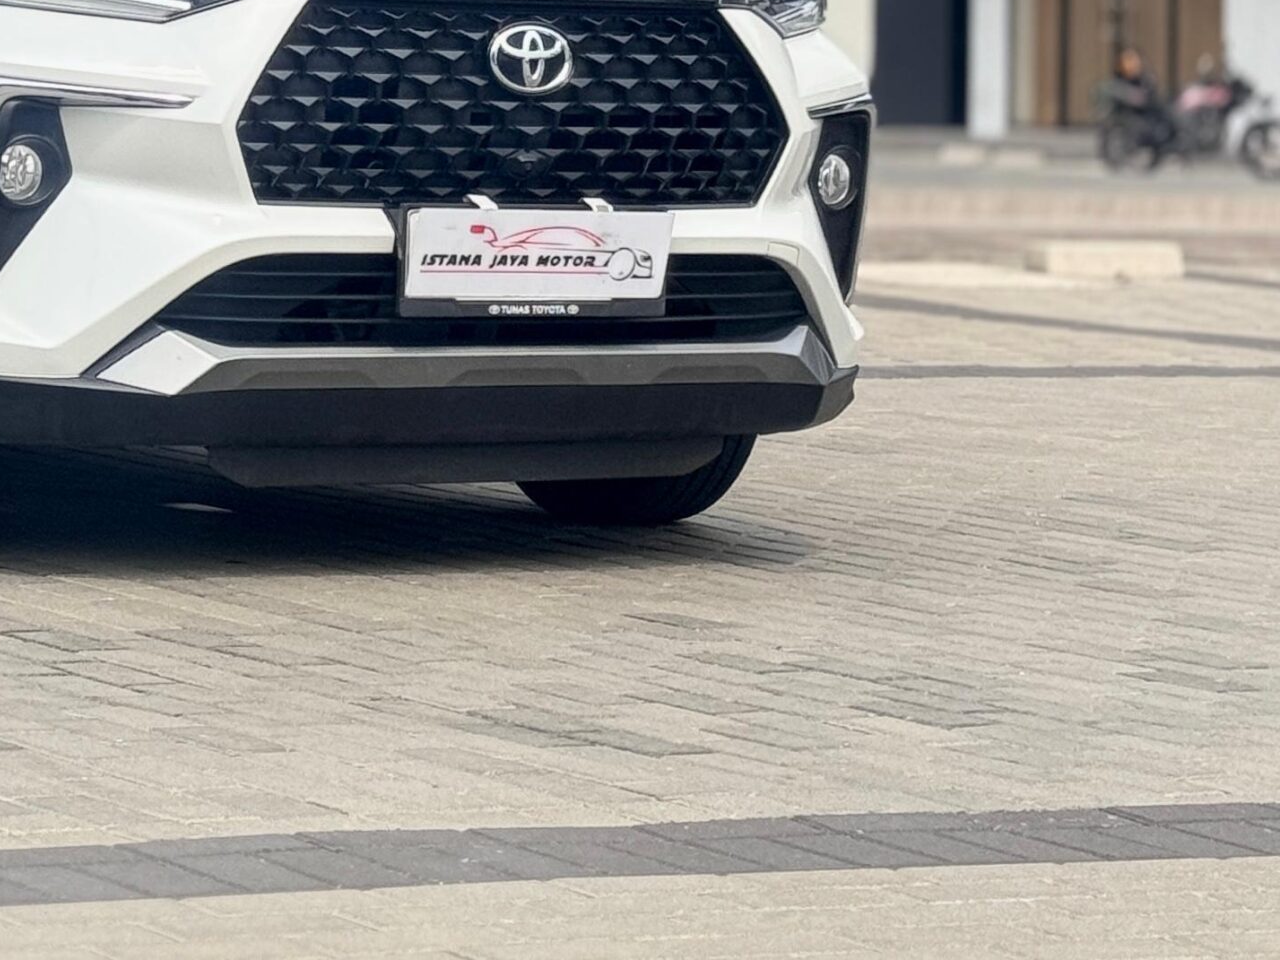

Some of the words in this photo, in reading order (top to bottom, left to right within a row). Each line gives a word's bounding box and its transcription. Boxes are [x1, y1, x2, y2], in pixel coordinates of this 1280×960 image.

[421, 254, 482, 266] ISTANA
[489, 254, 529, 269] JAYA
[536, 255, 596, 267] MOTOR
[501, 305, 530, 315] TUNAS
[532, 306, 566, 315] TOYOTA
